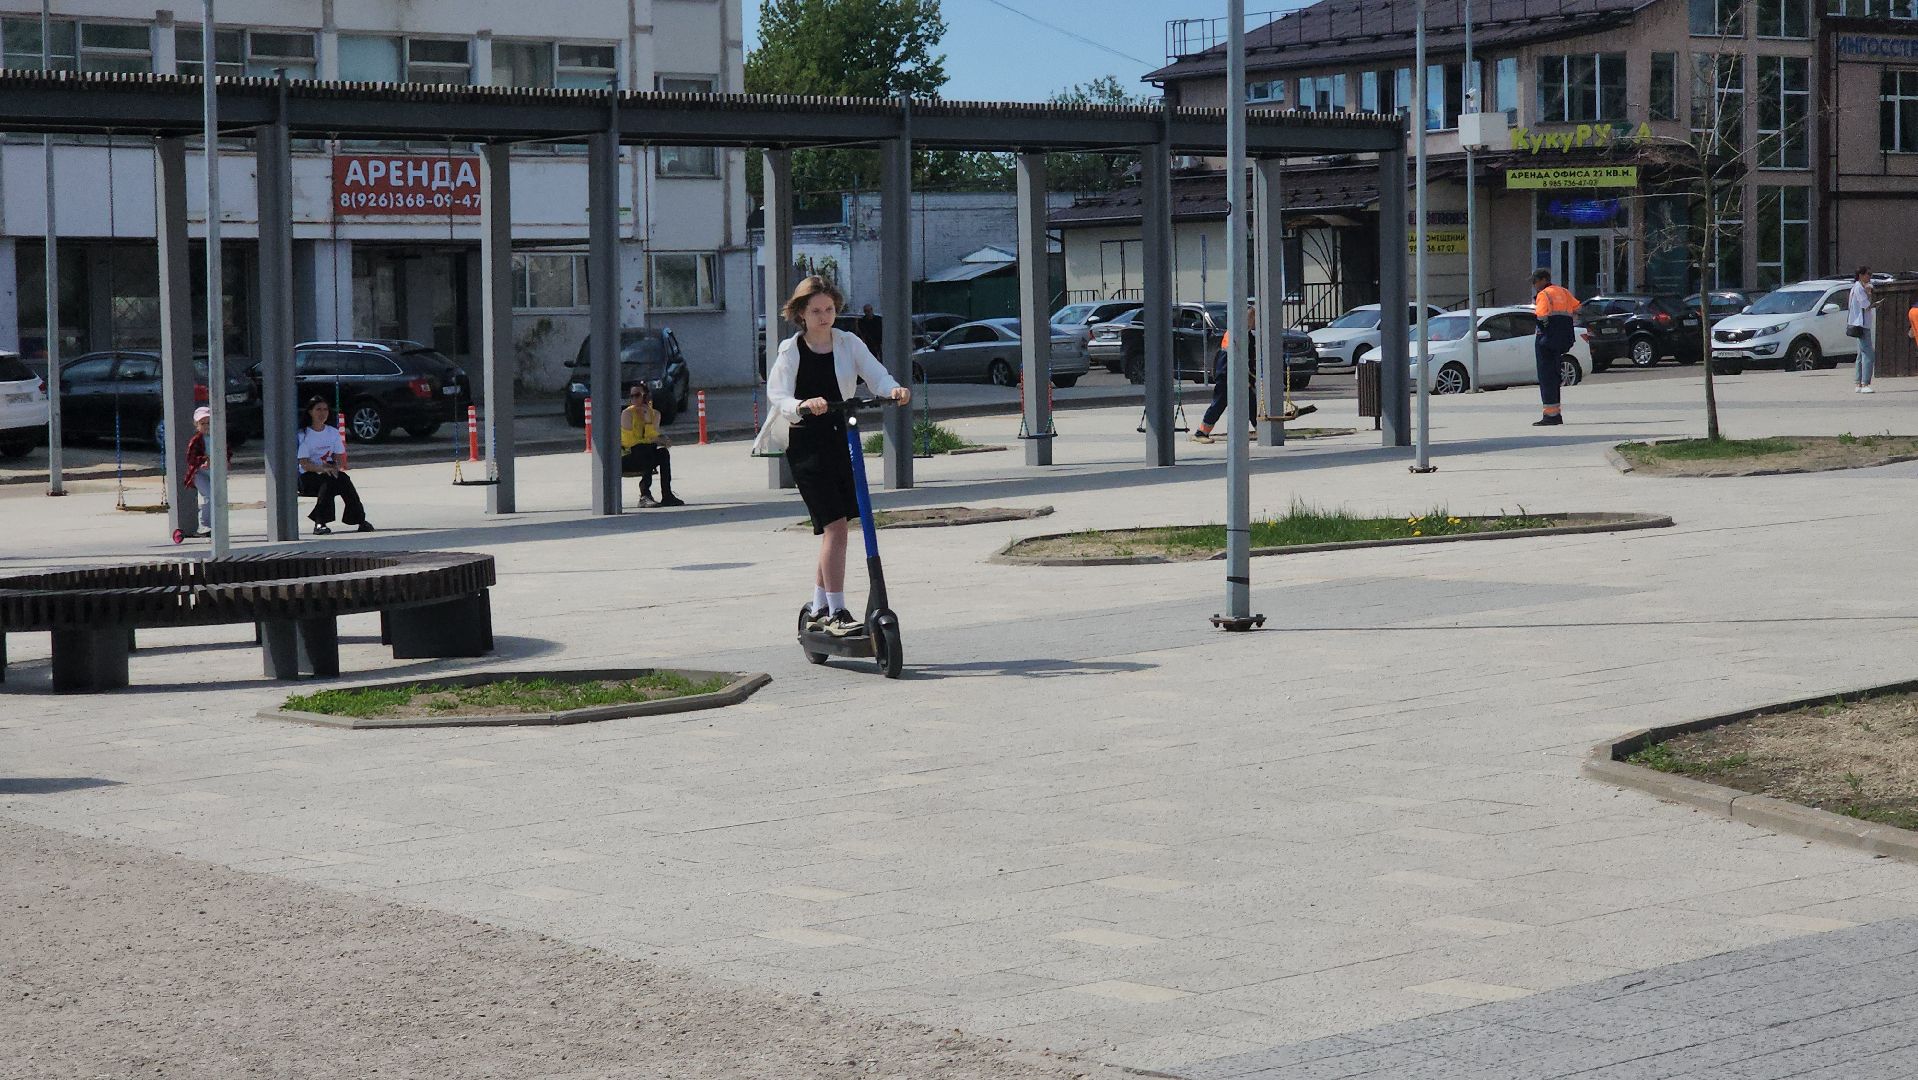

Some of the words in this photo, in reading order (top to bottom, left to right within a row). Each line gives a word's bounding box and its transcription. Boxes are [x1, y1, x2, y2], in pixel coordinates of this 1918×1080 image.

[344, 159, 477, 191] АРЕНДА
[1511, 171, 1551, 179] АРЕНДА
[1553, 170, 1590, 178] ОФИСА
[340, 192, 480, 209] 8(926)368-09-47
[1426, 233, 1466, 242] ОМЕЩЕНИЙ
